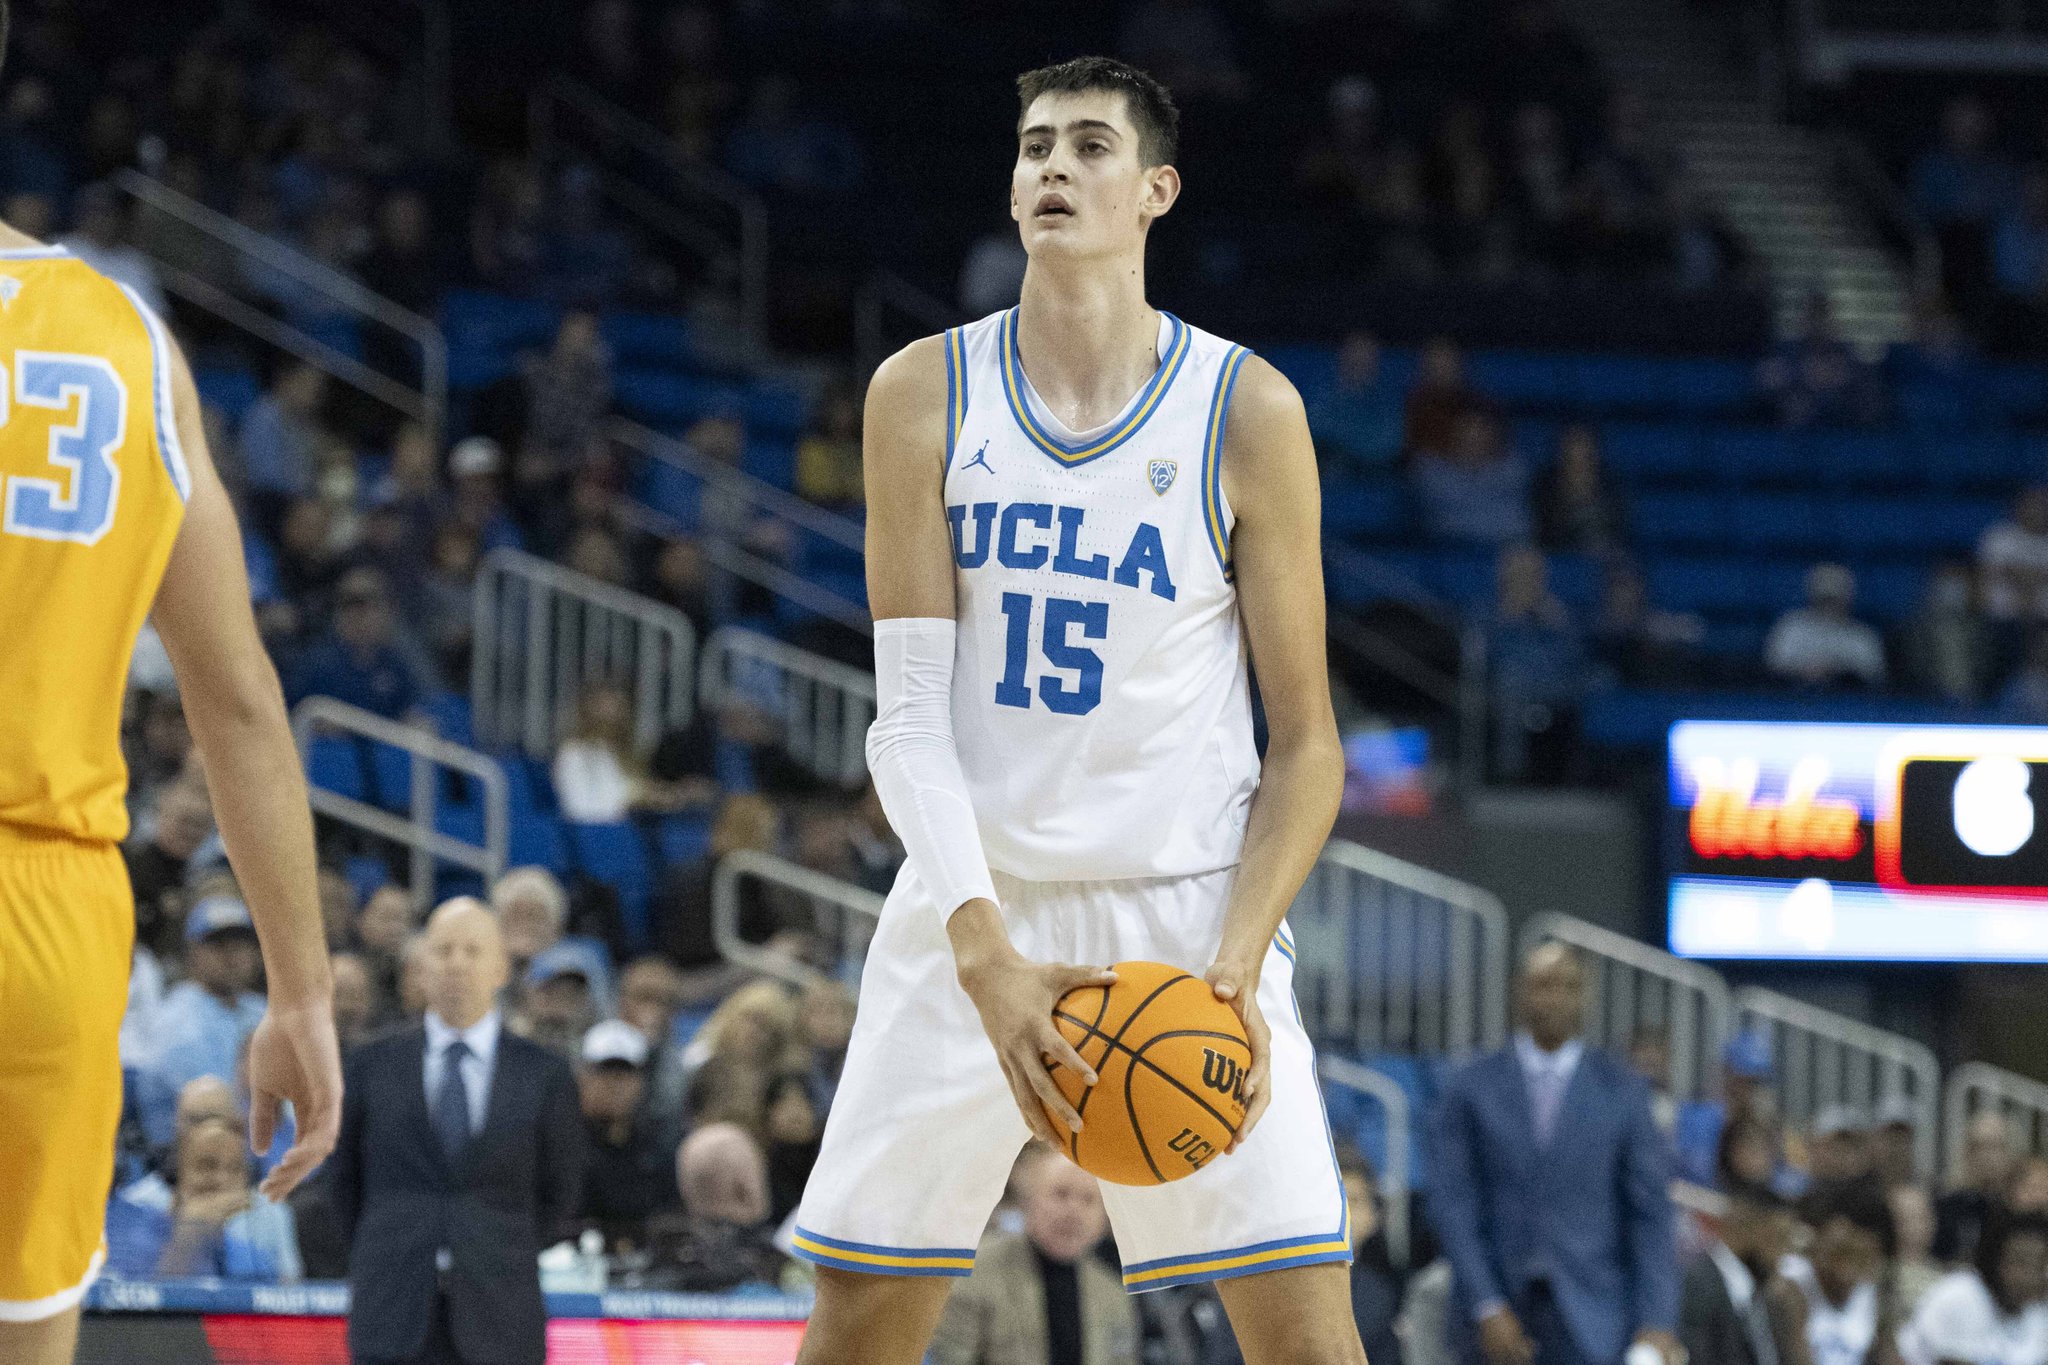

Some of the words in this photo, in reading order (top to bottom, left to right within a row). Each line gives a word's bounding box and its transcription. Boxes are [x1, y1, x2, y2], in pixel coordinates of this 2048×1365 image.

[0, 349, 127, 546] 3
[1150, 460, 1176, 481] PAC
[1154, 474, 1169, 488] 12
[947, 502, 1176, 602] UCLA
[995, 592, 1109, 715] 15
